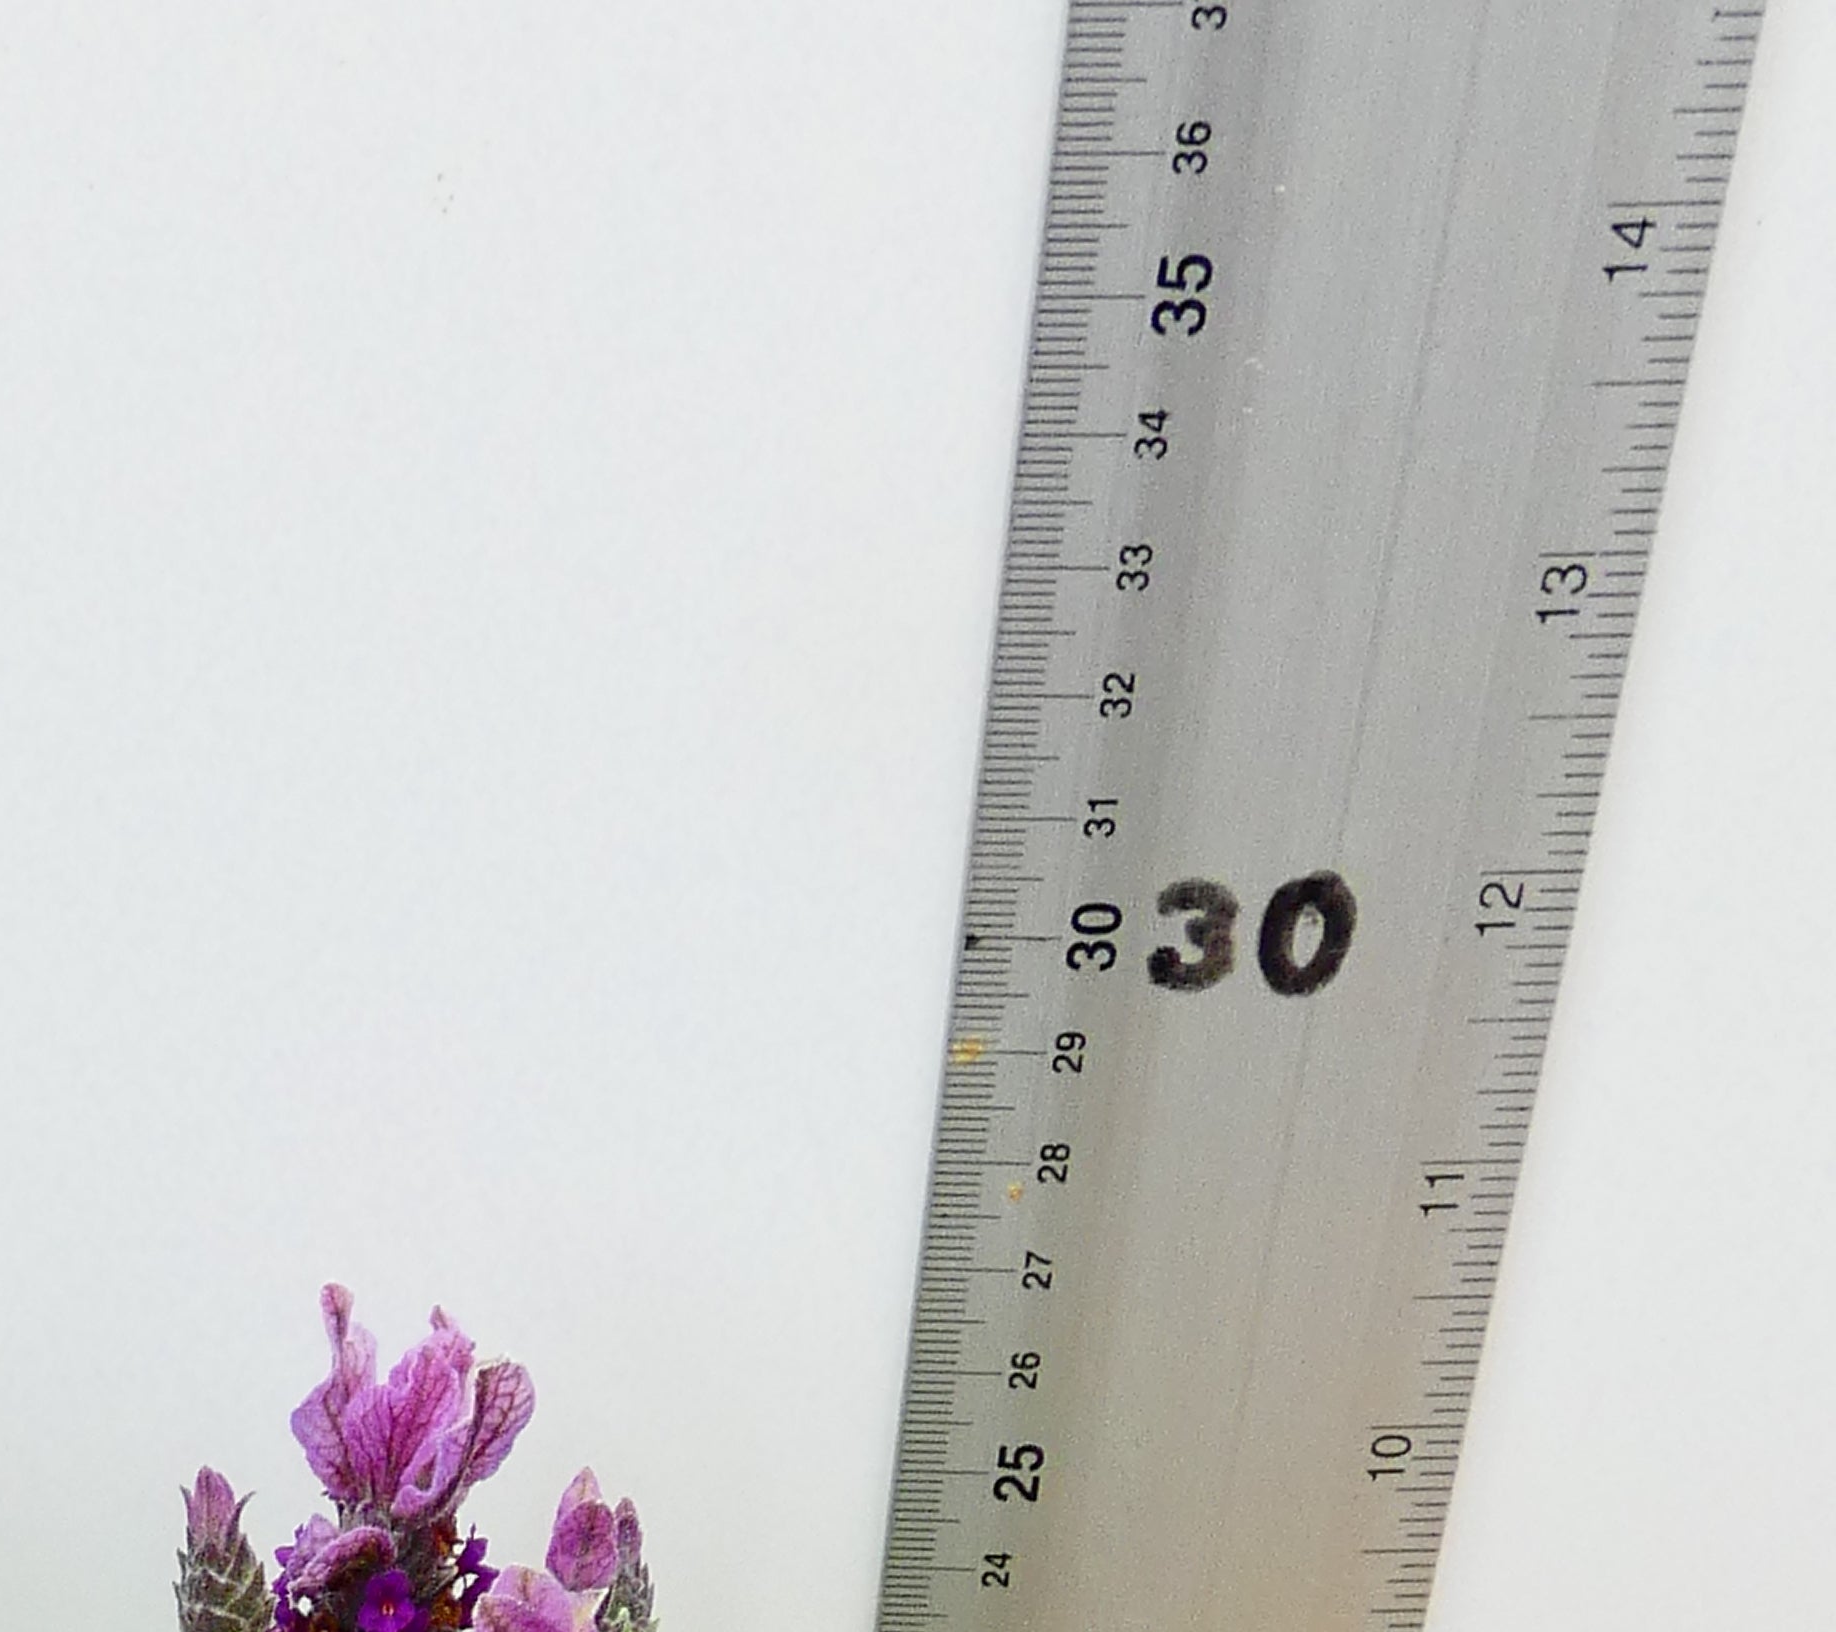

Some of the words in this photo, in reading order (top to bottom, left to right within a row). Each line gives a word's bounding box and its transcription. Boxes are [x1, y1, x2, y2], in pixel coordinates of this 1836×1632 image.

[1192, 0, 1228, 30] 3
[1172, 121, 1212, 175] 36
[1603, 217, 1656, 282] 14
[1151, 254, 1213, 337] 35
[1133, 410, 1169, 460] 34
[1116, 544, 1153, 592] 33
[1536, 562, 1588, 624] 13
[1099, 672, 1135, 718] 32
[1083, 797, 1119, 838] 31
[1146, 869, 1358, 996] 30
[1474, 882, 1524, 936] 12
[1066, 902, 1123, 972] 30
[1052, 1031, 1087, 1074] 29
[1037, 1142, 1071, 1183] 28
[1419, 1173, 1465, 1217] 11
[1021, 1251, 1053, 1290] 27
[1008, 1352, 1041, 1390] 26
[993, 1444, 1044, 1503] 25
[1367, 1434, 1412, 1482] 10
[981, 1552, 1013, 1588] 24
